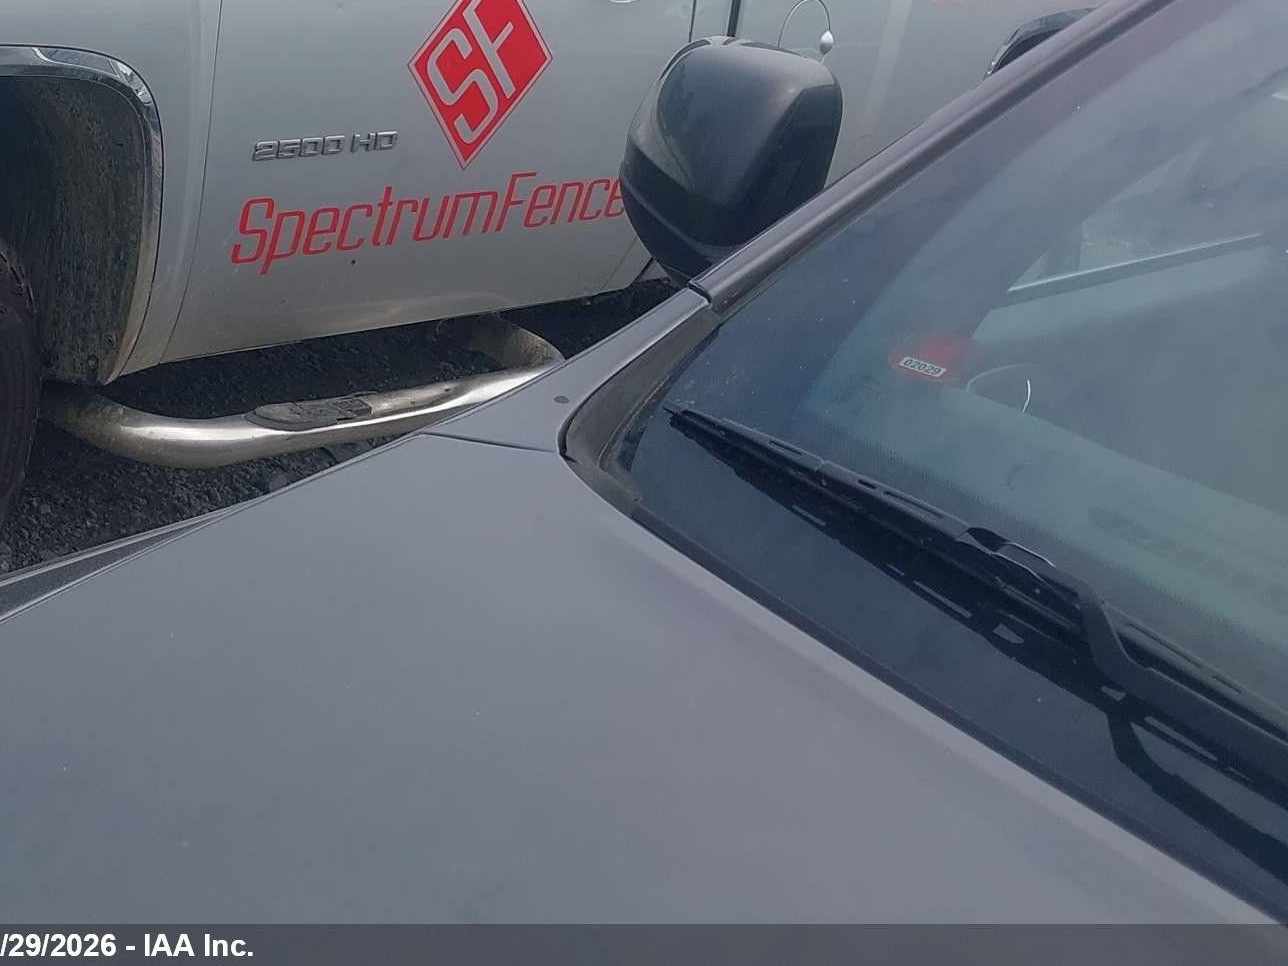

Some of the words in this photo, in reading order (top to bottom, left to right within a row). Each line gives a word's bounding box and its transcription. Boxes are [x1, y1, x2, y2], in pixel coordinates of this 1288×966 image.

[252, 134, 345, 161] 2500
[350, 131, 399, 153] HD
[231, 171, 626, 275] SpectrumFence
[903, 358, 941, 376] 02029
